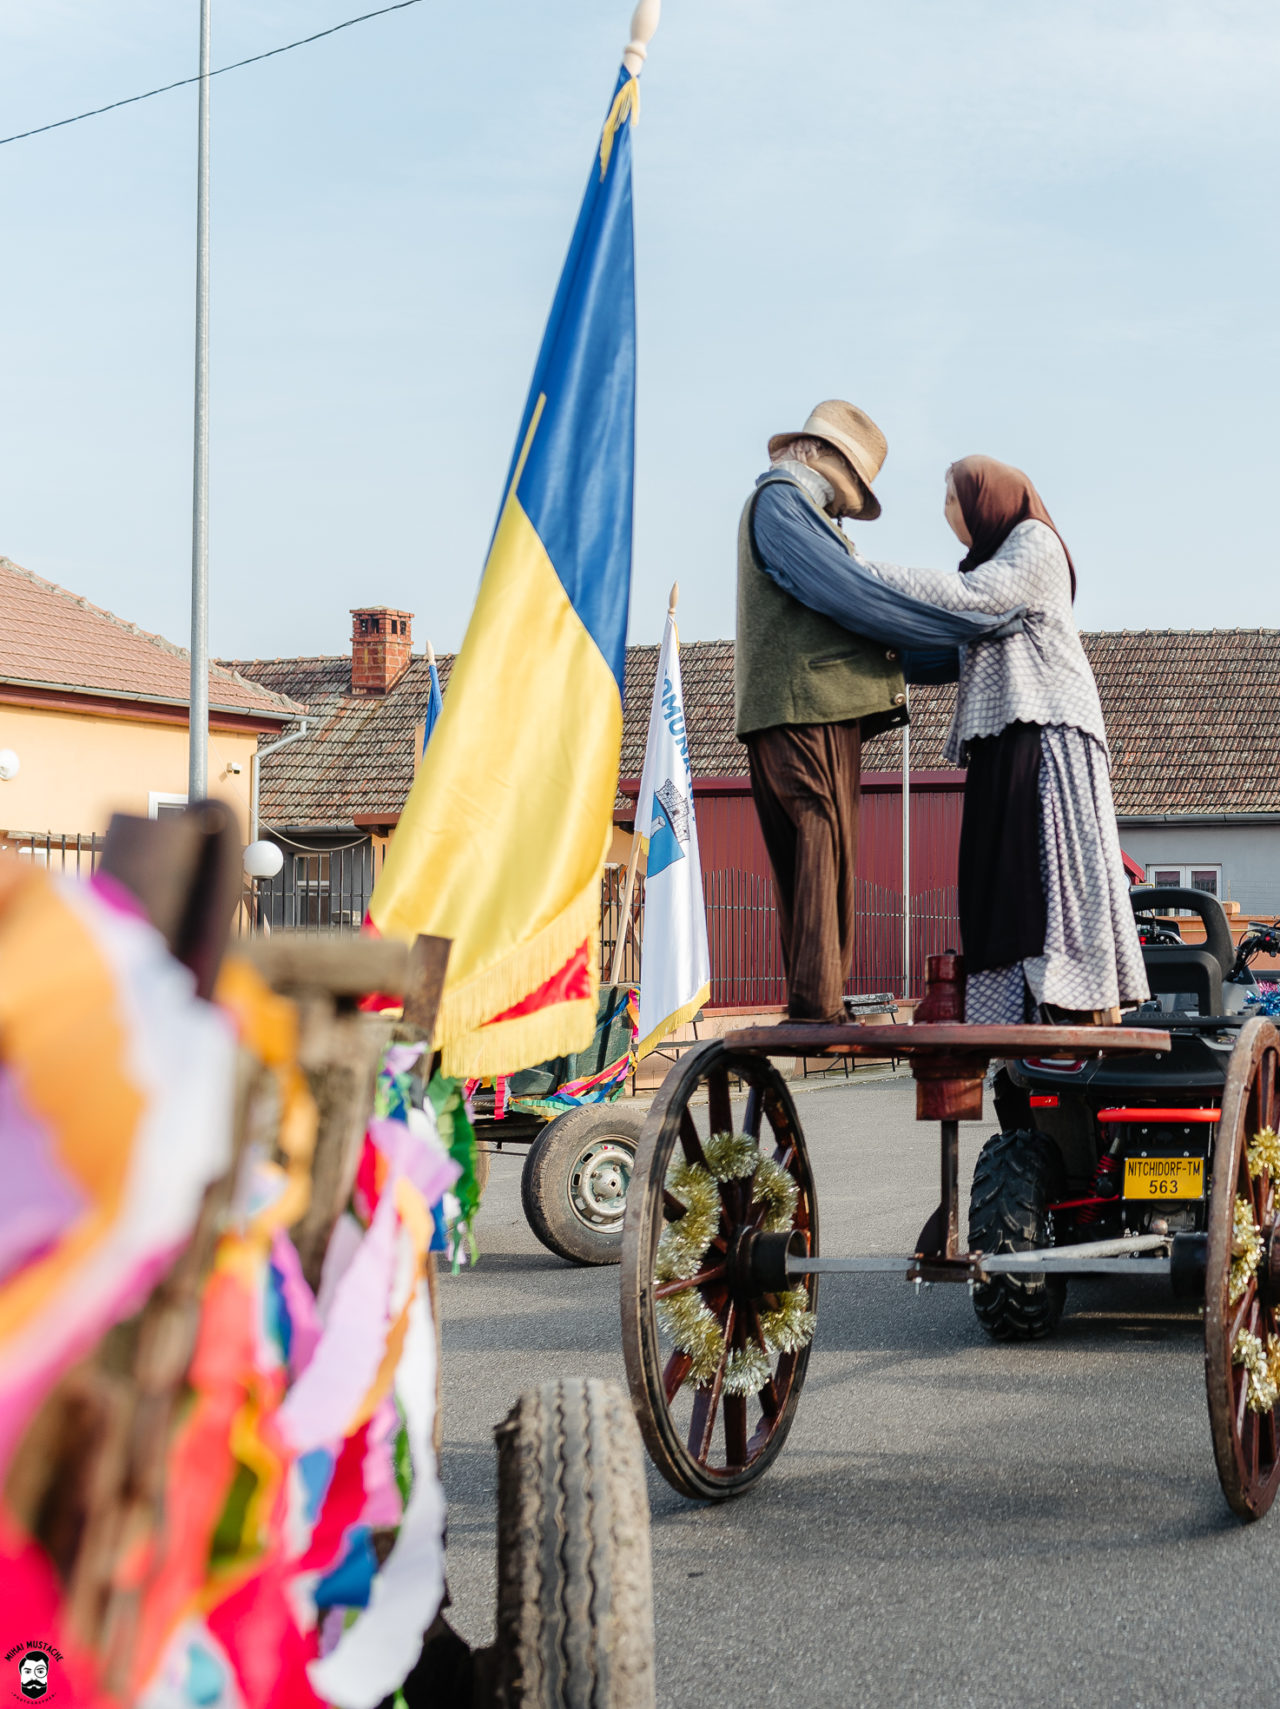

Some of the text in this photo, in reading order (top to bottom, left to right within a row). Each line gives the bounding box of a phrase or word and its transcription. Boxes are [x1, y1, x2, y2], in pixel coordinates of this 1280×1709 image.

[662, 668, 691, 775] OMUN
[1127, 1161, 1201, 1177] NITCHIDORF-TM
[1149, 1180, 1178, 1194] 563
